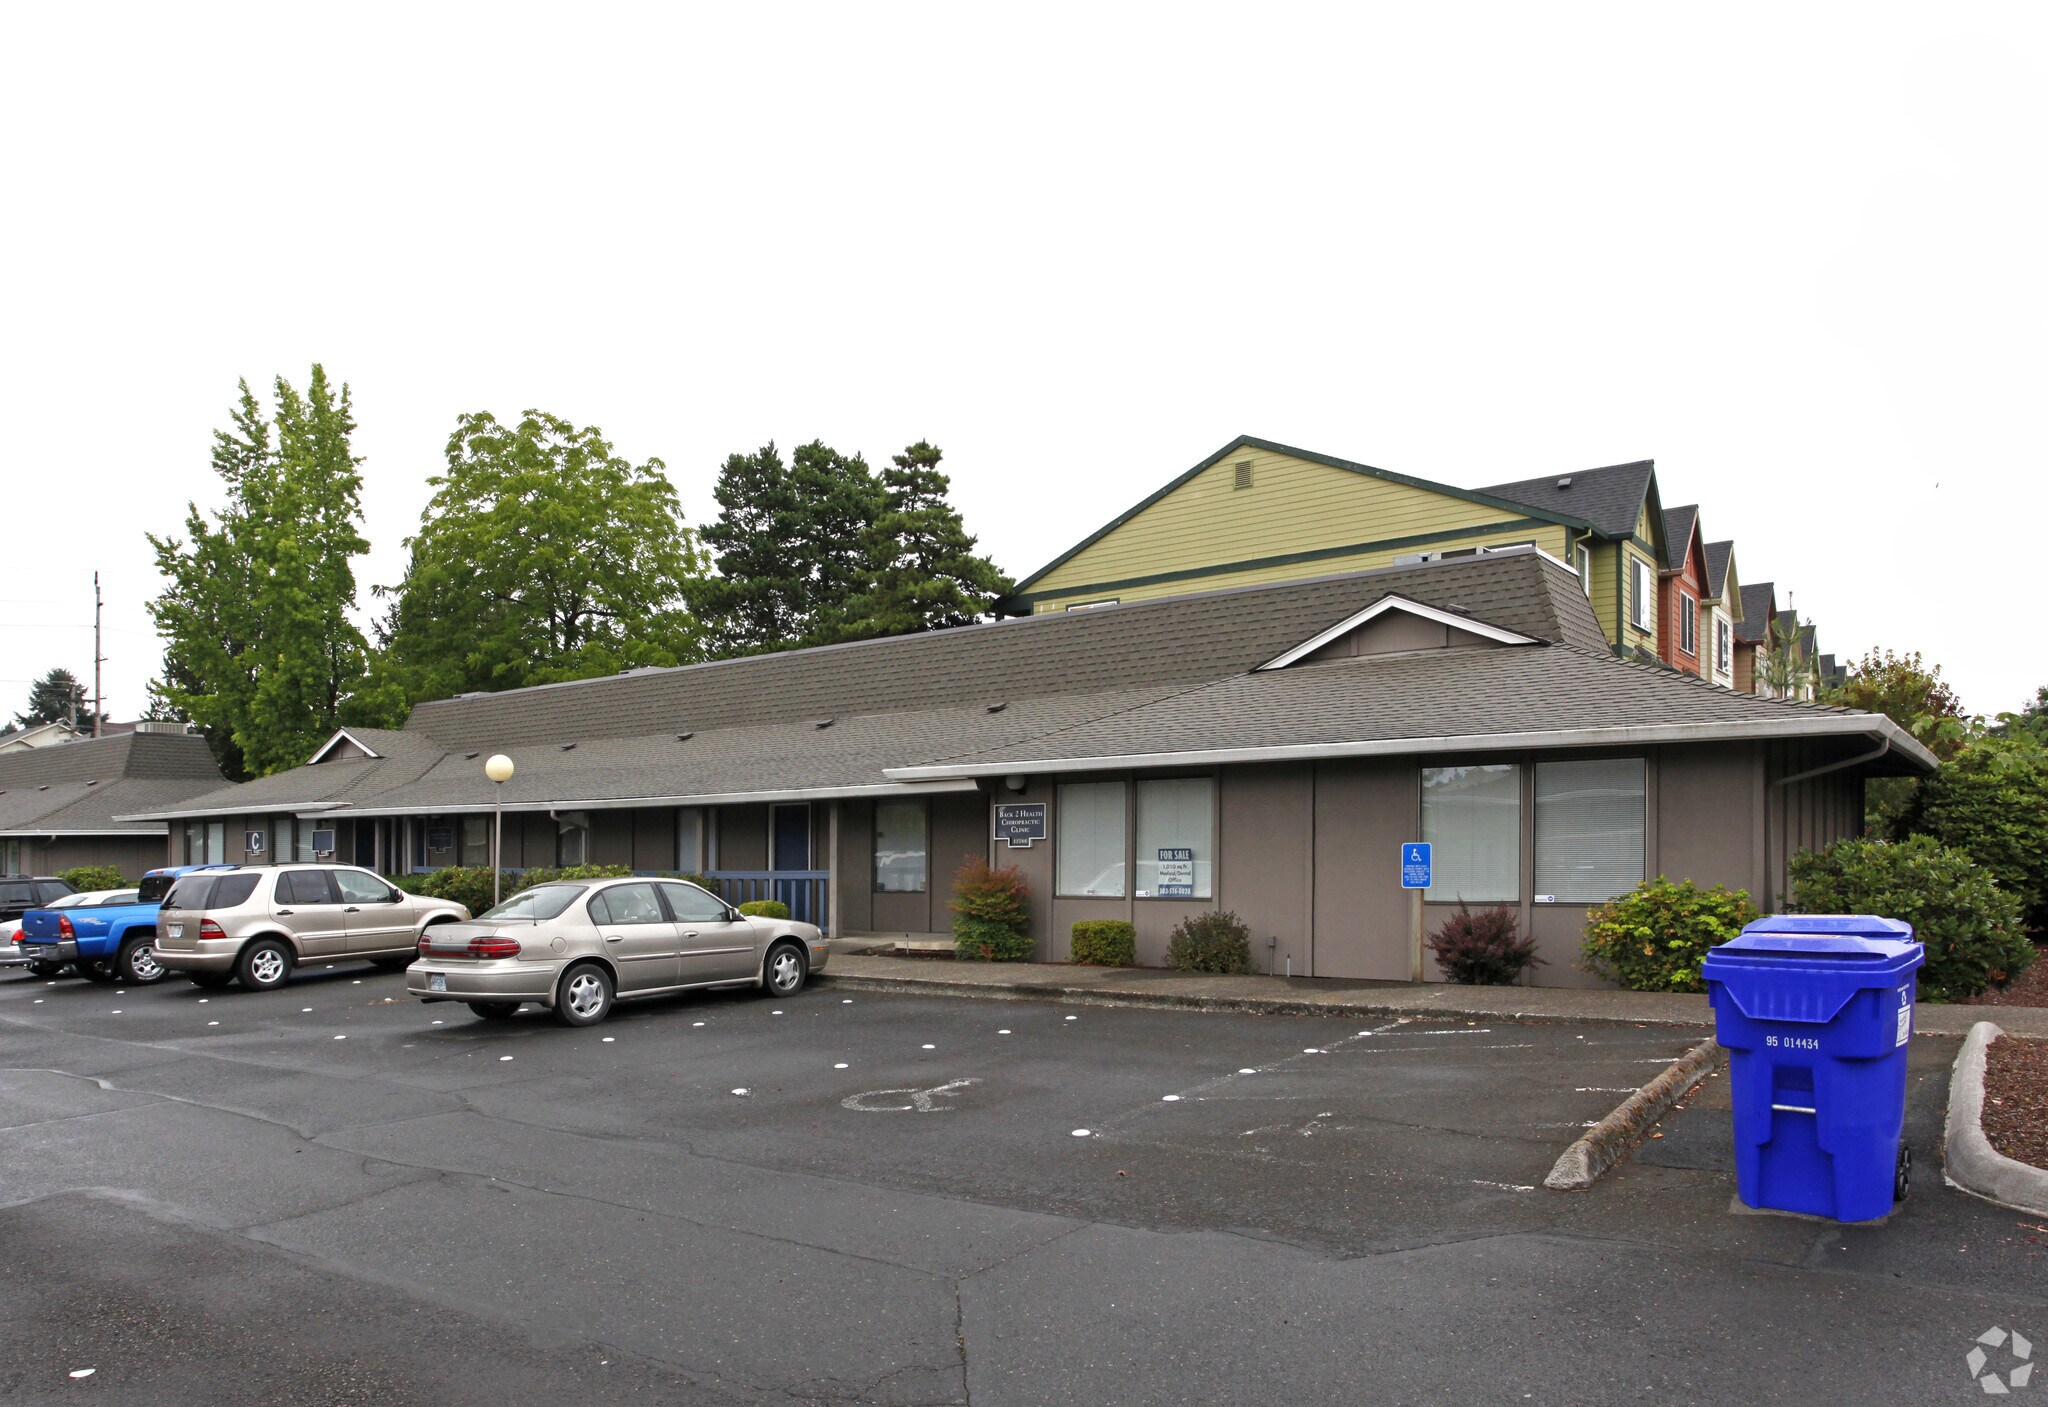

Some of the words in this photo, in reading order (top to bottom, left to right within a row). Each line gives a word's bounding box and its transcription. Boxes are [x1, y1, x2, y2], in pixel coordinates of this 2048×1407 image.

[252, 833, 259, 849] C
[1160, 850, 1173, 859] FOR
[1174, 850, 1189, 859] SALE
[1766, 1035, 1778, 1047] 95
[1784, 1037, 1818, 1049] 014434
